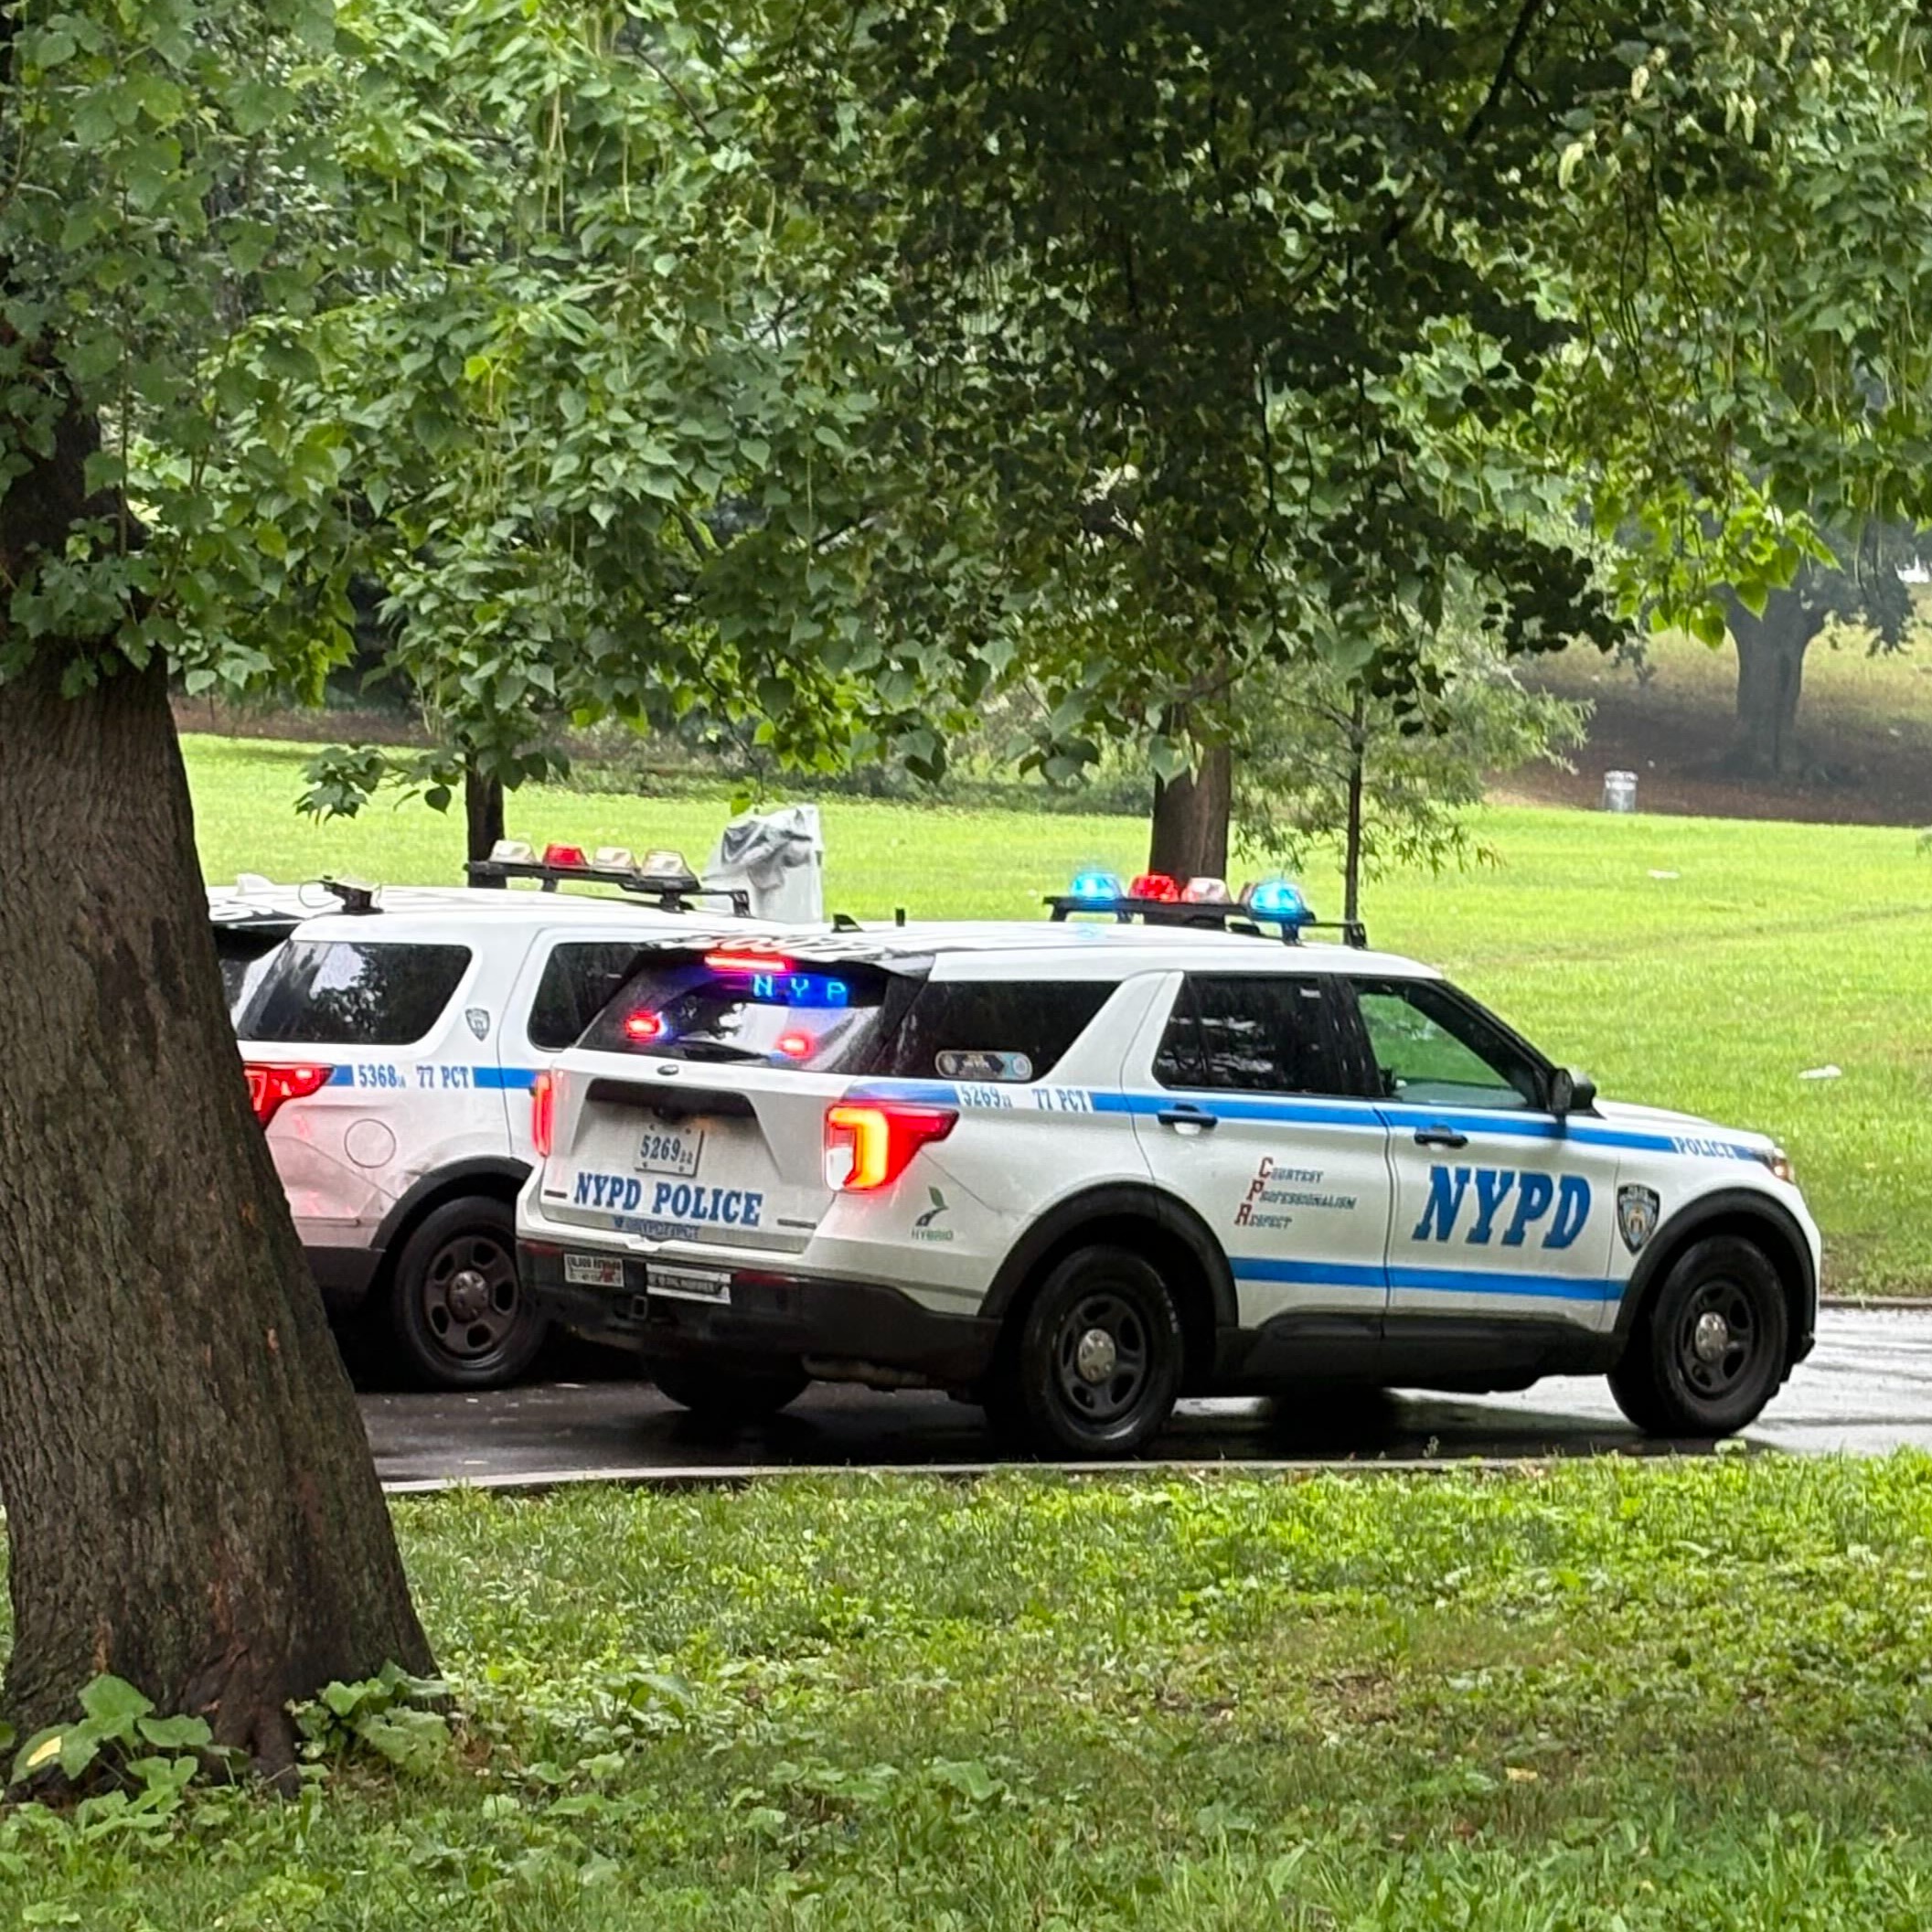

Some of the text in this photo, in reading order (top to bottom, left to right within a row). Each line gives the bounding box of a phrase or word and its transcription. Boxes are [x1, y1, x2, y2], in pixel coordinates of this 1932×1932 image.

[416, 1064, 434, 1089] 77
[441, 1065, 469, 1089] PCT
[1031, 1088, 1052, 1110] 77
[1056, 1089, 1088, 1112] PCT
[1674, 1137, 1735, 1159] POLICE
[574, 1171, 763, 1227] NYPD POLICE
[1412, 1165, 1591, 1249] NYPD
[911, 1228, 954, 1242] HYBRID
